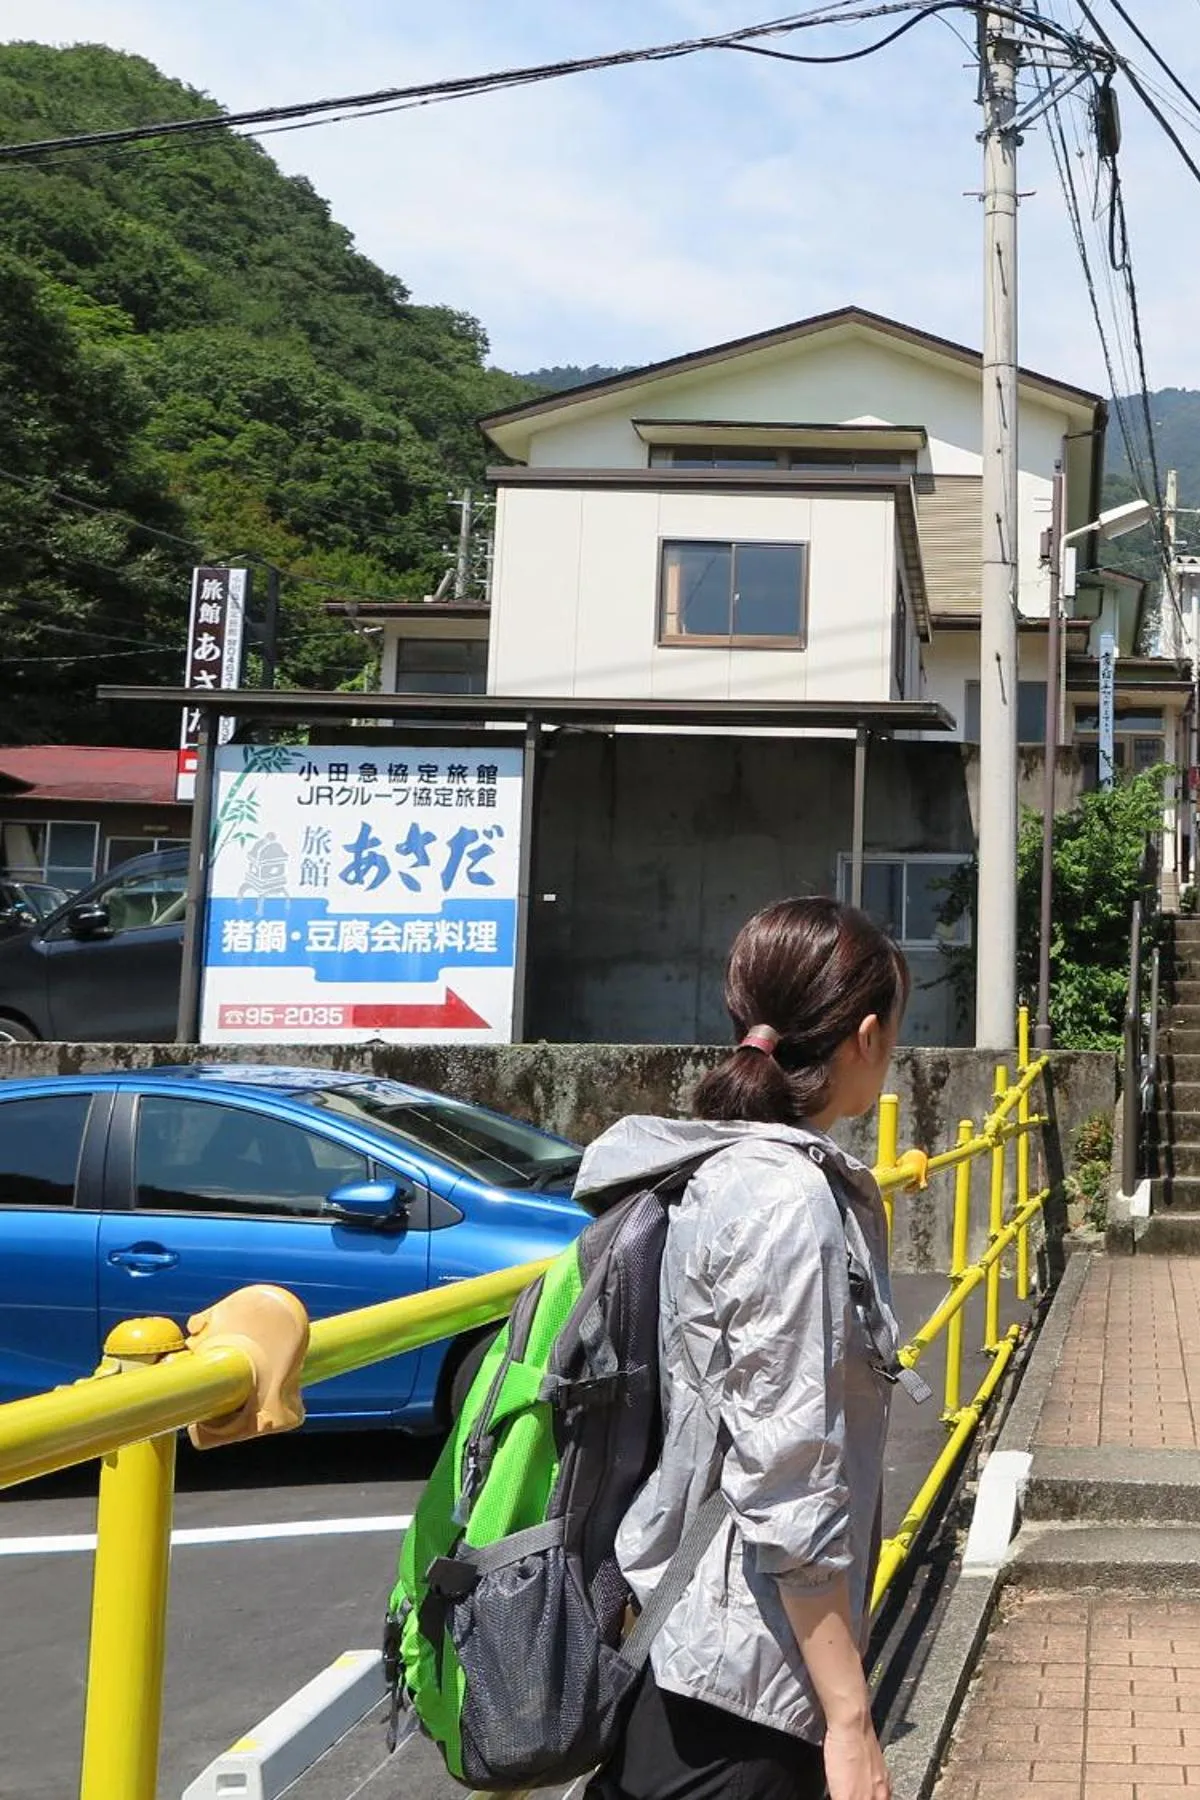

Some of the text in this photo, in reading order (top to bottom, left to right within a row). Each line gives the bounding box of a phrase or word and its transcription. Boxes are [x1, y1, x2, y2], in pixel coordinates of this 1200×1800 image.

[297, 762, 499, 785] 小田急協定旅館
[296, 785, 498, 809] JRグループ協定旅館
[299, 821, 505, 892] 旅館 あさだ
[222, 919, 499, 955] 猪鍋・豆腐会席料理
[245, 1006, 344, 1026] 95-2035
